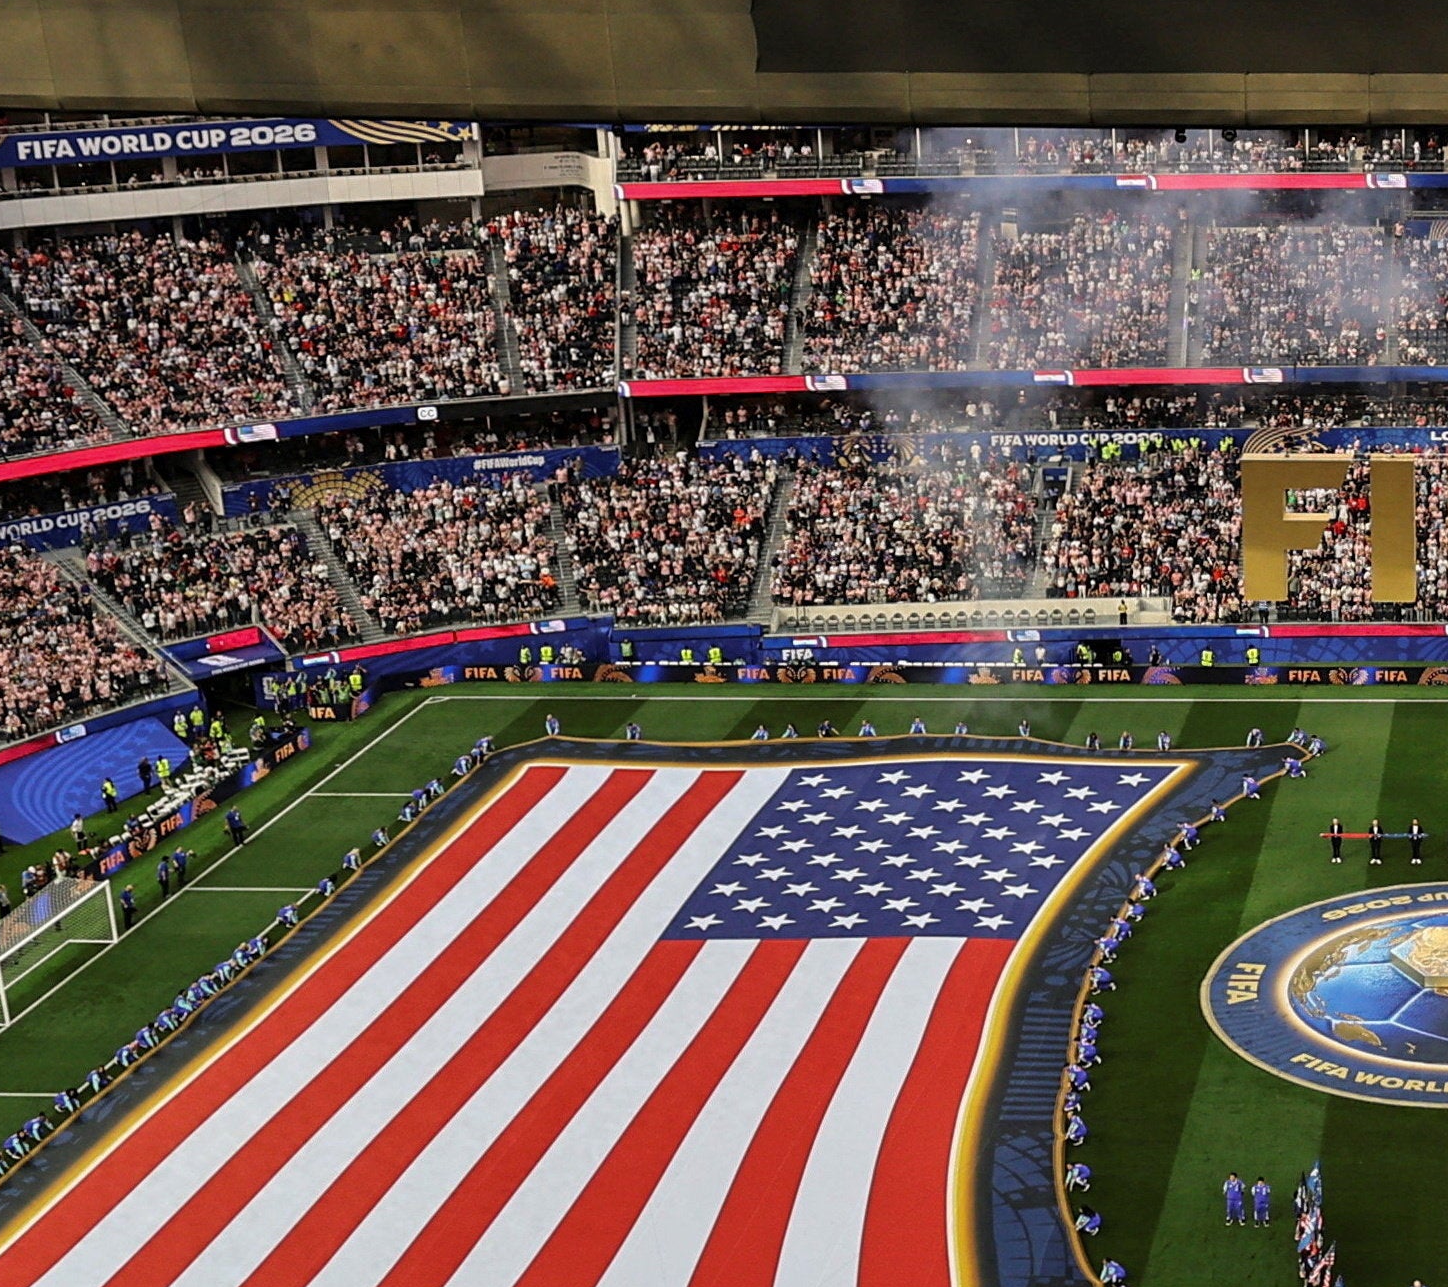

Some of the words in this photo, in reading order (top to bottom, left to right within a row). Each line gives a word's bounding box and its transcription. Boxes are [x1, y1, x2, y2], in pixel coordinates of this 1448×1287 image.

[17, 139, 75, 159] FIFA
[76, 131, 172, 157] WORLD
[176, 129, 226, 149] CUP
[230, 123, 317, 146] 2026
[420, 409, 435, 418] CC
[991, 434, 1023, 447] FIFA
[1025, 433, 1078, 446] WORLD
[473, 455, 545, 470] #FIFAWorldCup
[56, 512, 90, 530] CUP
[92, 501, 151, 522] 2026
[782, 649, 813, 661] FIFA
[465, 667, 497, 680] FIFA
[551, 667, 583, 680] FIFA
[738, 668, 769, 680] FIFA
[824, 668, 856, 680] FIFA
[1012, 669, 1044, 681] FIFA
[1098, 669, 1130, 681] FIFA
[1288, 670, 1320, 682] FIFA
[1375, 670, 1407, 682] FIFA
[161, 813, 183, 836] FIFA
[100, 850, 126, 874] FIFA
[1323, 894, 1415, 922] 2026
[1227, 962, 1267, 1006] FIFA
[1289, 1052, 1349, 1080] FIFA
